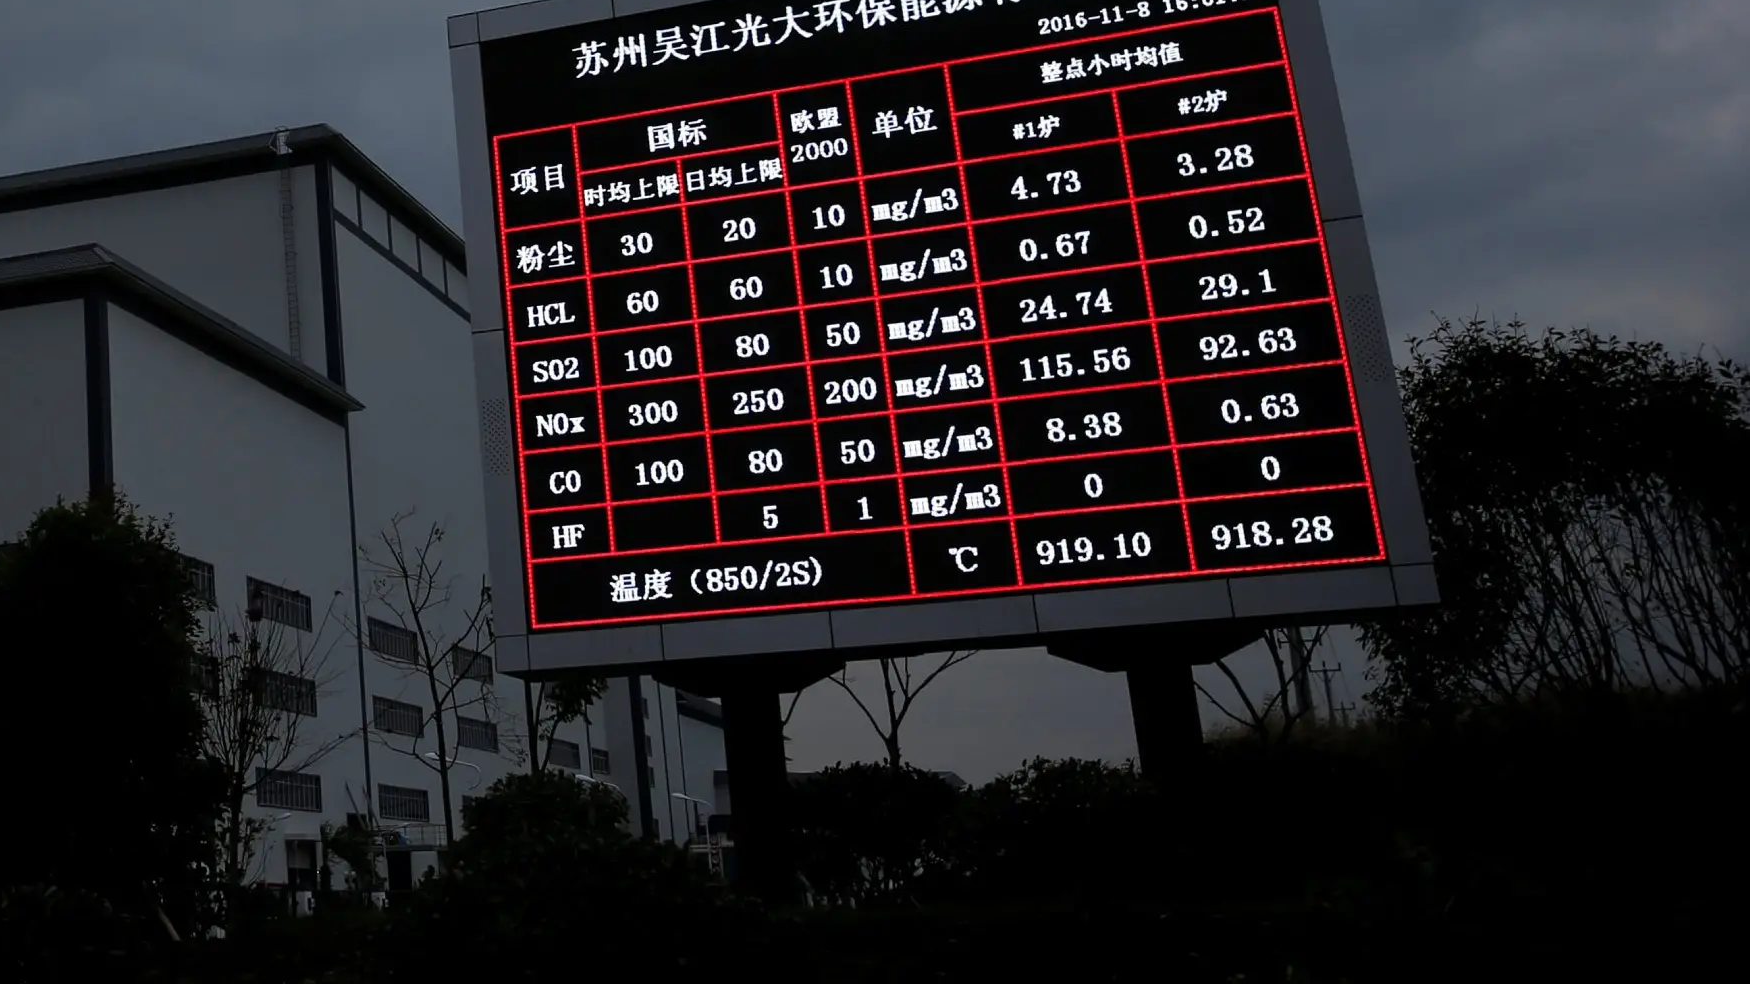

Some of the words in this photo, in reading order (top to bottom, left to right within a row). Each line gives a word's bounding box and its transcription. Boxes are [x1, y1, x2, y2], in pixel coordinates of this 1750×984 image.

[1038, 2, 1150, 34] 2016-11-8
[1040, 42, 1183, 83] 整点小时均值
[1177, 89, 1227, 115] #2炉
[648, 119, 706, 152] 国标
[791, 107, 842, 133] 欧盟
[872, 106, 937, 138] 单位
[1012, 115, 1060, 139] #1炉
[791, 138, 848, 162] 2000
[511, 164, 565, 194] 项目
[584, 174, 680, 206] 时均上限
[686, 158, 783, 192] 日均上限
[516, 241, 575, 273] 粉尘
[621, 232, 653, 256] 30
[723, 218, 756, 242] 20
[812, 205, 845, 229] 10
[871, 188, 958, 221] mg/m3
[1011, 170, 1081, 200] 4.73
[1177, 144, 1254, 176] 3.28
[527, 302, 575, 327] HCL
[627, 290, 659, 314] 60
[730, 276, 763, 300] 60
[820, 264, 853, 288] 10
[880, 249, 967, 282] mg/m3
[1019, 231, 1090, 261] 0.67
[1189, 207, 1265, 238] 0.52
[533, 357, 579, 382] SO2
[625, 346, 672, 371] 100
[736, 334, 769, 357] 80
[827, 322, 860, 347] 50
[888, 307, 976, 340] mg/m3
[1020, 288, 1112, 322] 24.74
[1199, 269, 1276, 300] 29.1
[629, 400, 678, 426] 300
[733, 388, 784, 414] 250
[824, 377, 877, 404] 200
[895, 364, 984, 398] mg/m3
[1020, 347, 1130, 381] 115.56
[1200, 327, 1296, 360] 92.63
[635, 460, 683, 485] 100
[748, 449, 783, 473] 80
[841, 439, 875, 464] 50
[903, 426, 993, 459] mg/m3
[1046, 412, 1122, 442] 8.38
[1221, 393, 1299, 423] 0.63
[552, 524, 585, 549] HF
[763, 505, 778, 529] 5
[858, 497, 873, 520] 1
[910, 483, 1001, 517] mg/m3
[1084, 474, 1103, 497] 0
[1261, 456, 1280, 480] 0
[1036, 532, 1151, 565] 919.10
[1212, 516, 1333, 550] 918.28
